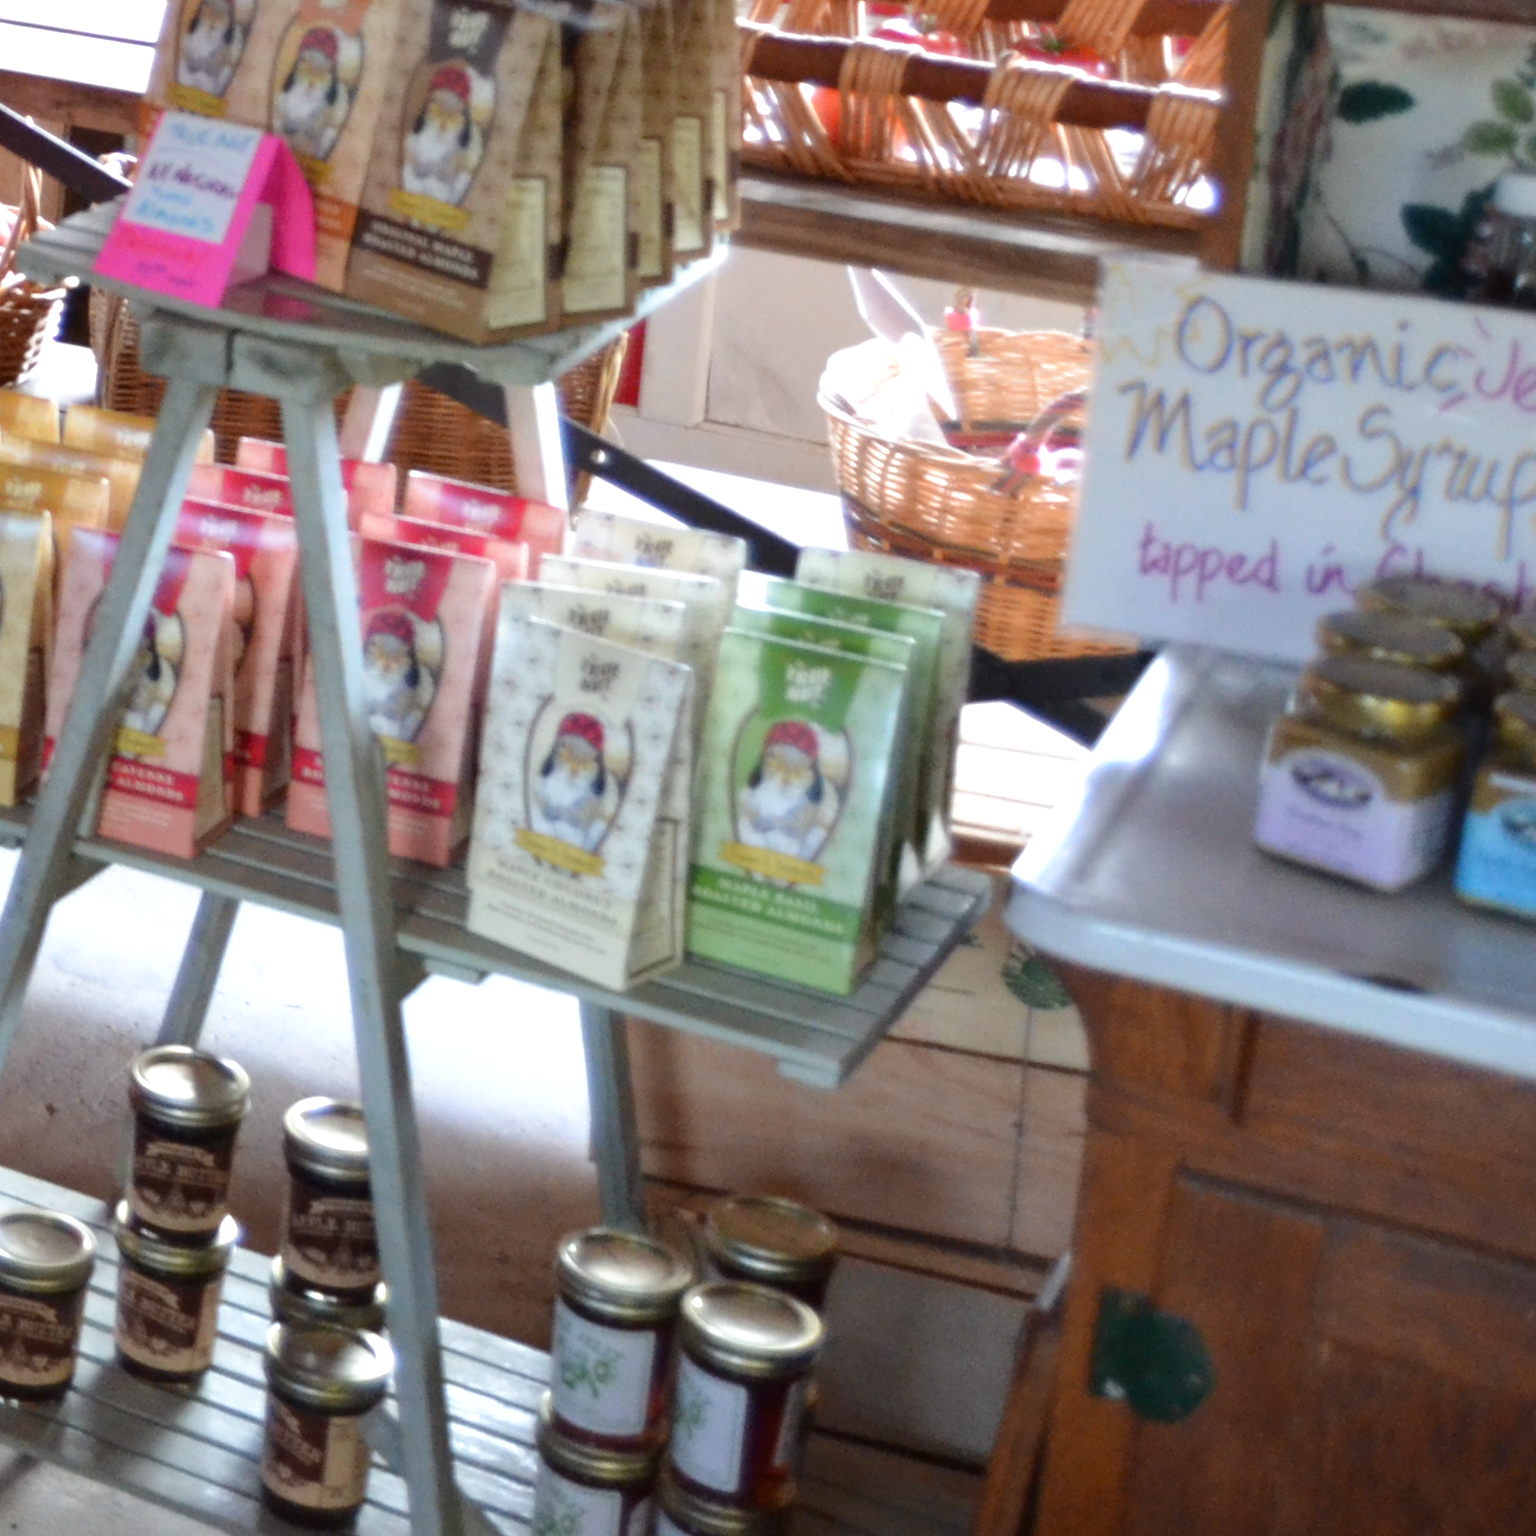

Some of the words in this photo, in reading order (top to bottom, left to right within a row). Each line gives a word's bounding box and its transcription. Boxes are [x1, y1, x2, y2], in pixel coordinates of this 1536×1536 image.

[1175, 293, 1461, 412] Organic
[1117, 381, 1338, 511] Maple
[1339, 404, 1536, 561] Syrup
[1138, 520, 1281, 603] tapped
[1305, 545, 1356, 597] in
